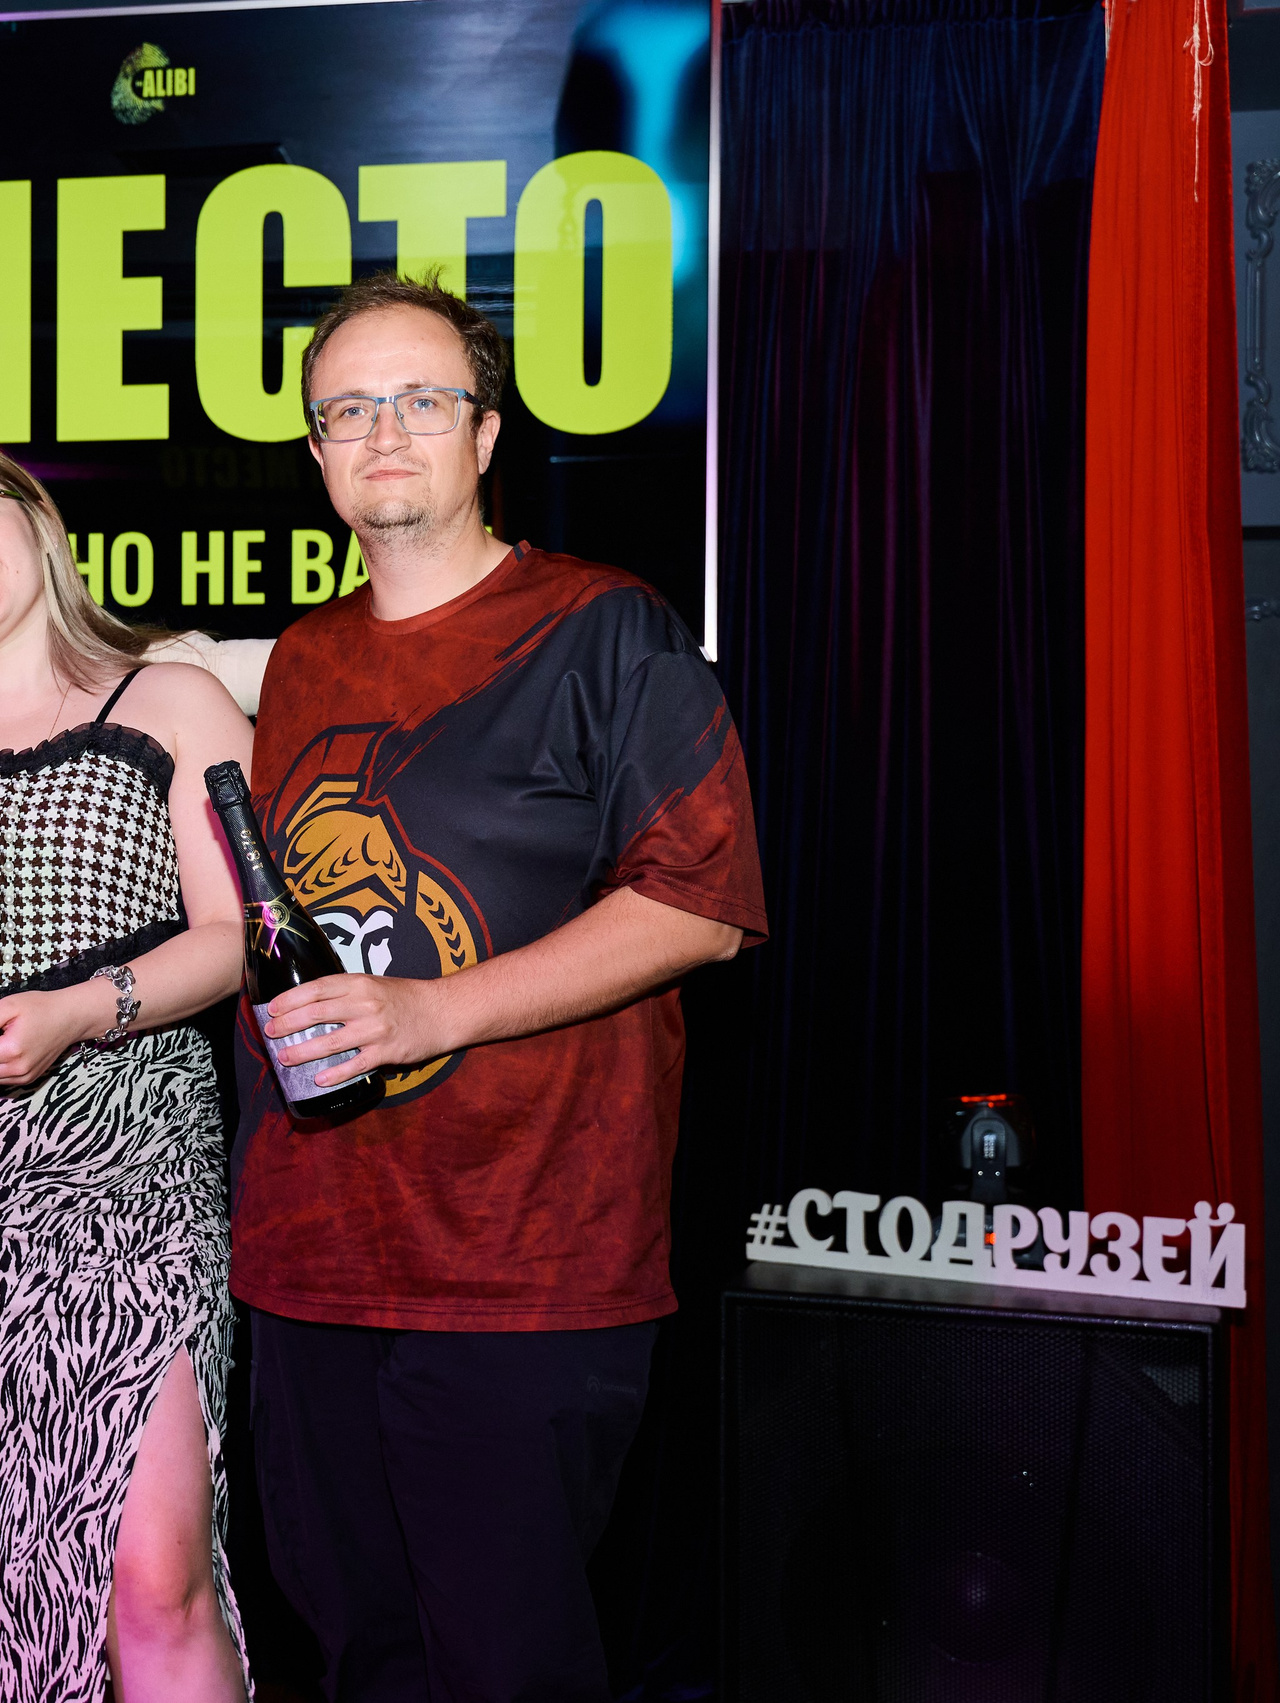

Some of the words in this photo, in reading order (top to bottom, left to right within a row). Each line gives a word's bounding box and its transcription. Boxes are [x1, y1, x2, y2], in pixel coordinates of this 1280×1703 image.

[142, 66, 196, 98] ALIBI
[67, 531, 154, 607] НО
[181, 529, 266, 606] НЕ
[746, 1187, 1247, 1303] #СТОДРУЗЕЙ
